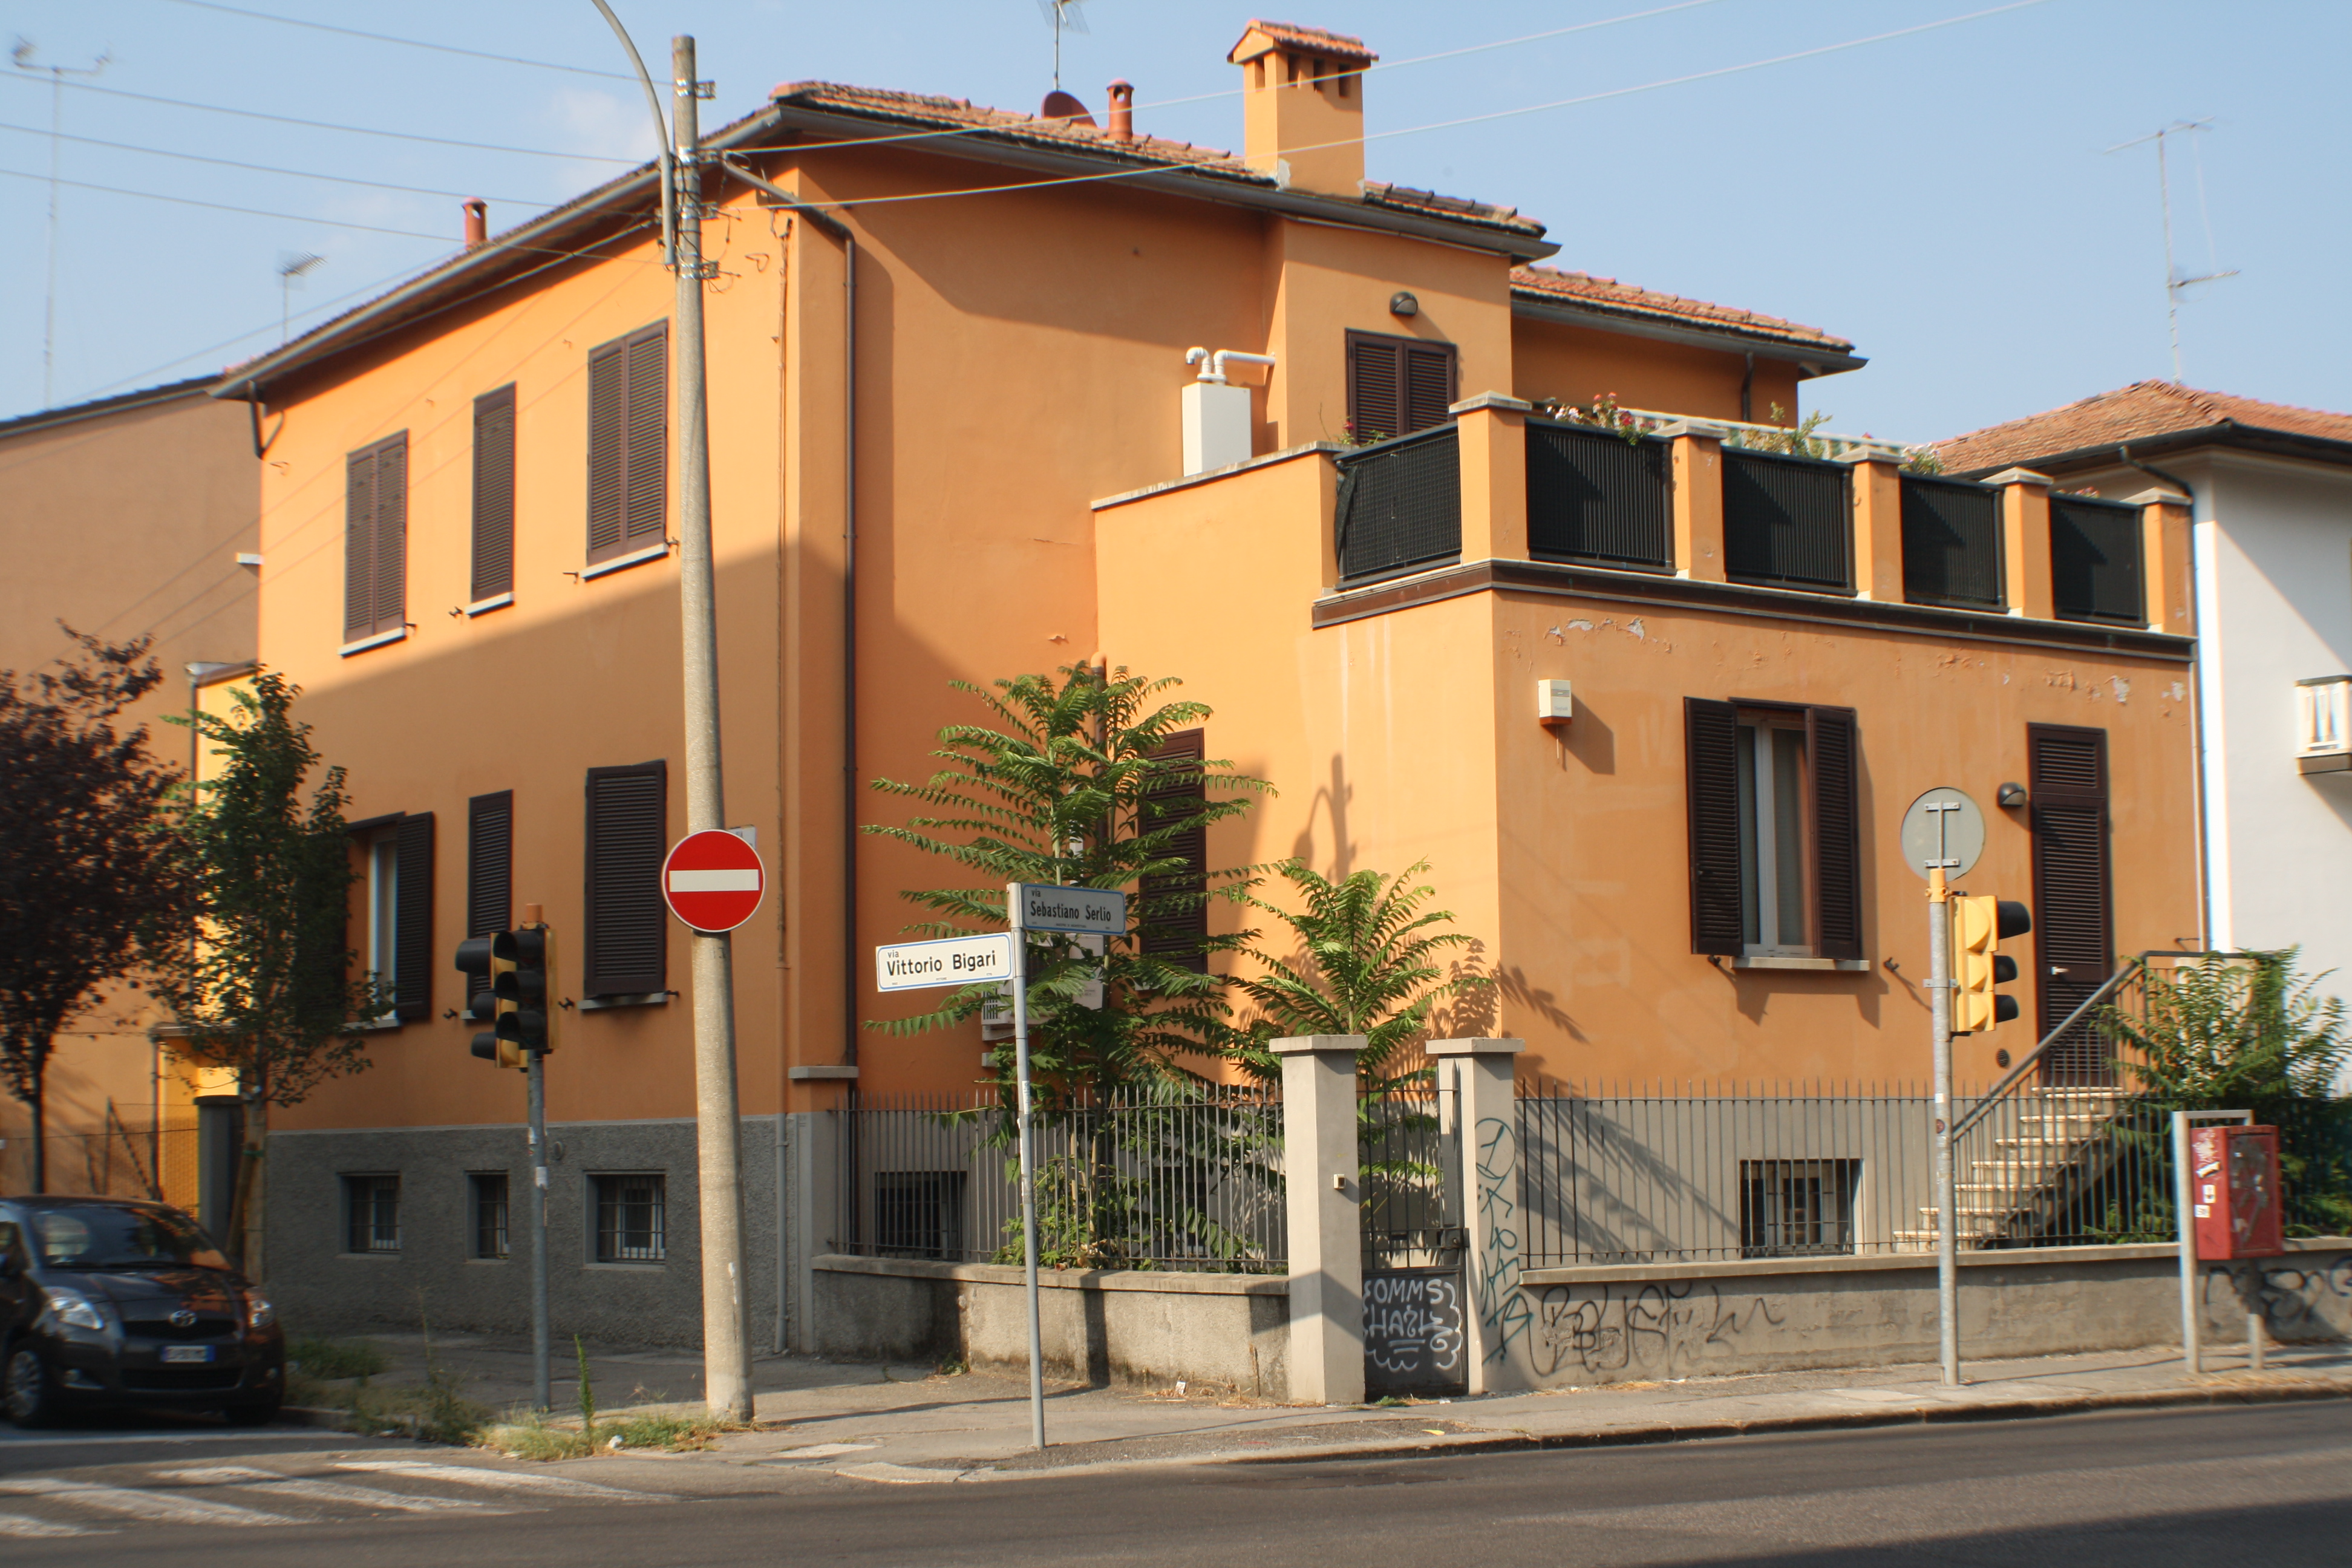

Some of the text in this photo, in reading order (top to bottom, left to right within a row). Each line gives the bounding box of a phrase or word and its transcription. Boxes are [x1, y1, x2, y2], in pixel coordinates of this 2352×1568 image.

[1031, 888, 1041, 897] via
[1030, 900, 1111, 921] Sebastiano Serlio
[887, 949, 900, 958] via
[886, 950, 996, 976] Vittorio Bigari
